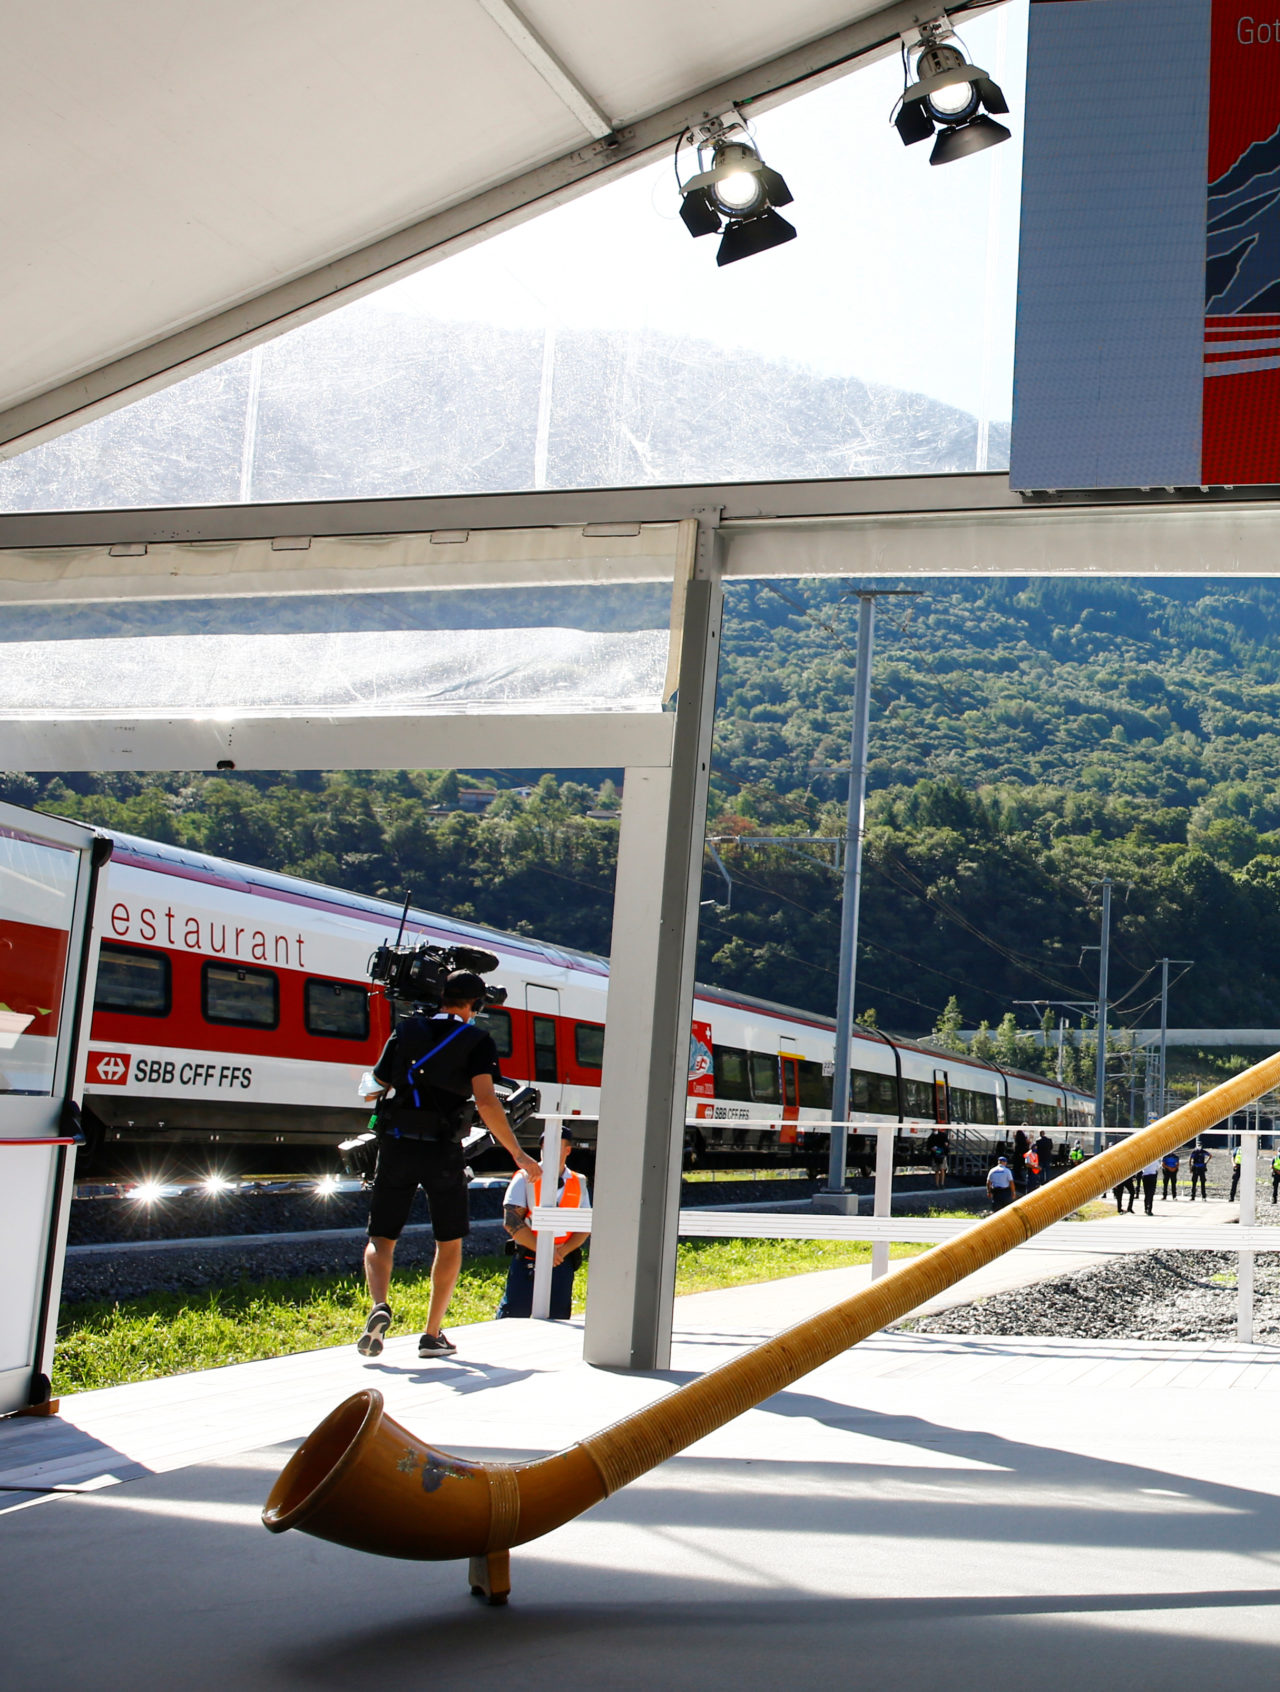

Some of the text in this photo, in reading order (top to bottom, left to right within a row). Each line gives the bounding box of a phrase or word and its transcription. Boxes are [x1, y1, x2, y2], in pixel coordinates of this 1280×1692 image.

[134, 1058, 252, 1089] SBB CFF FFS
[715, 1106, 727, 1120] SBB
